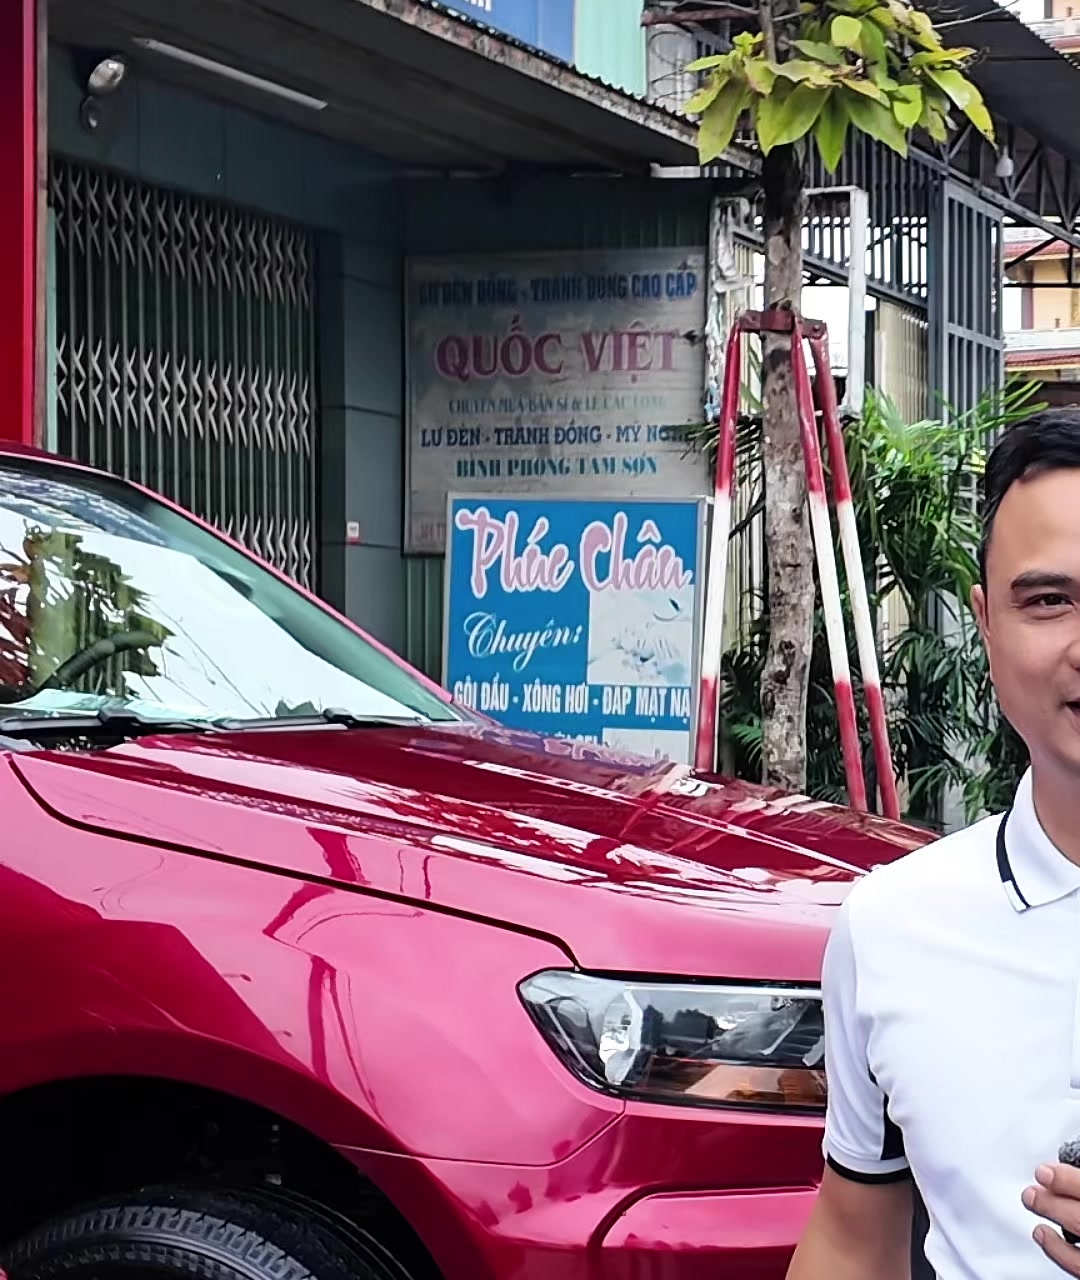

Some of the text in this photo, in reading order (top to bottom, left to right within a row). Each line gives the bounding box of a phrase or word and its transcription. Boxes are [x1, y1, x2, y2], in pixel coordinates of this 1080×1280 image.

[631, 273, 662, 299] CAO
[436, 314, 677, 384] QUỐC VIỆT
[455, 507, 575, 598] Phúc
[464, 612, 584, 672] Chuyên:
[522, 677, 561, 713] XÔNG
[564, 682, 589, 714] HƠI
